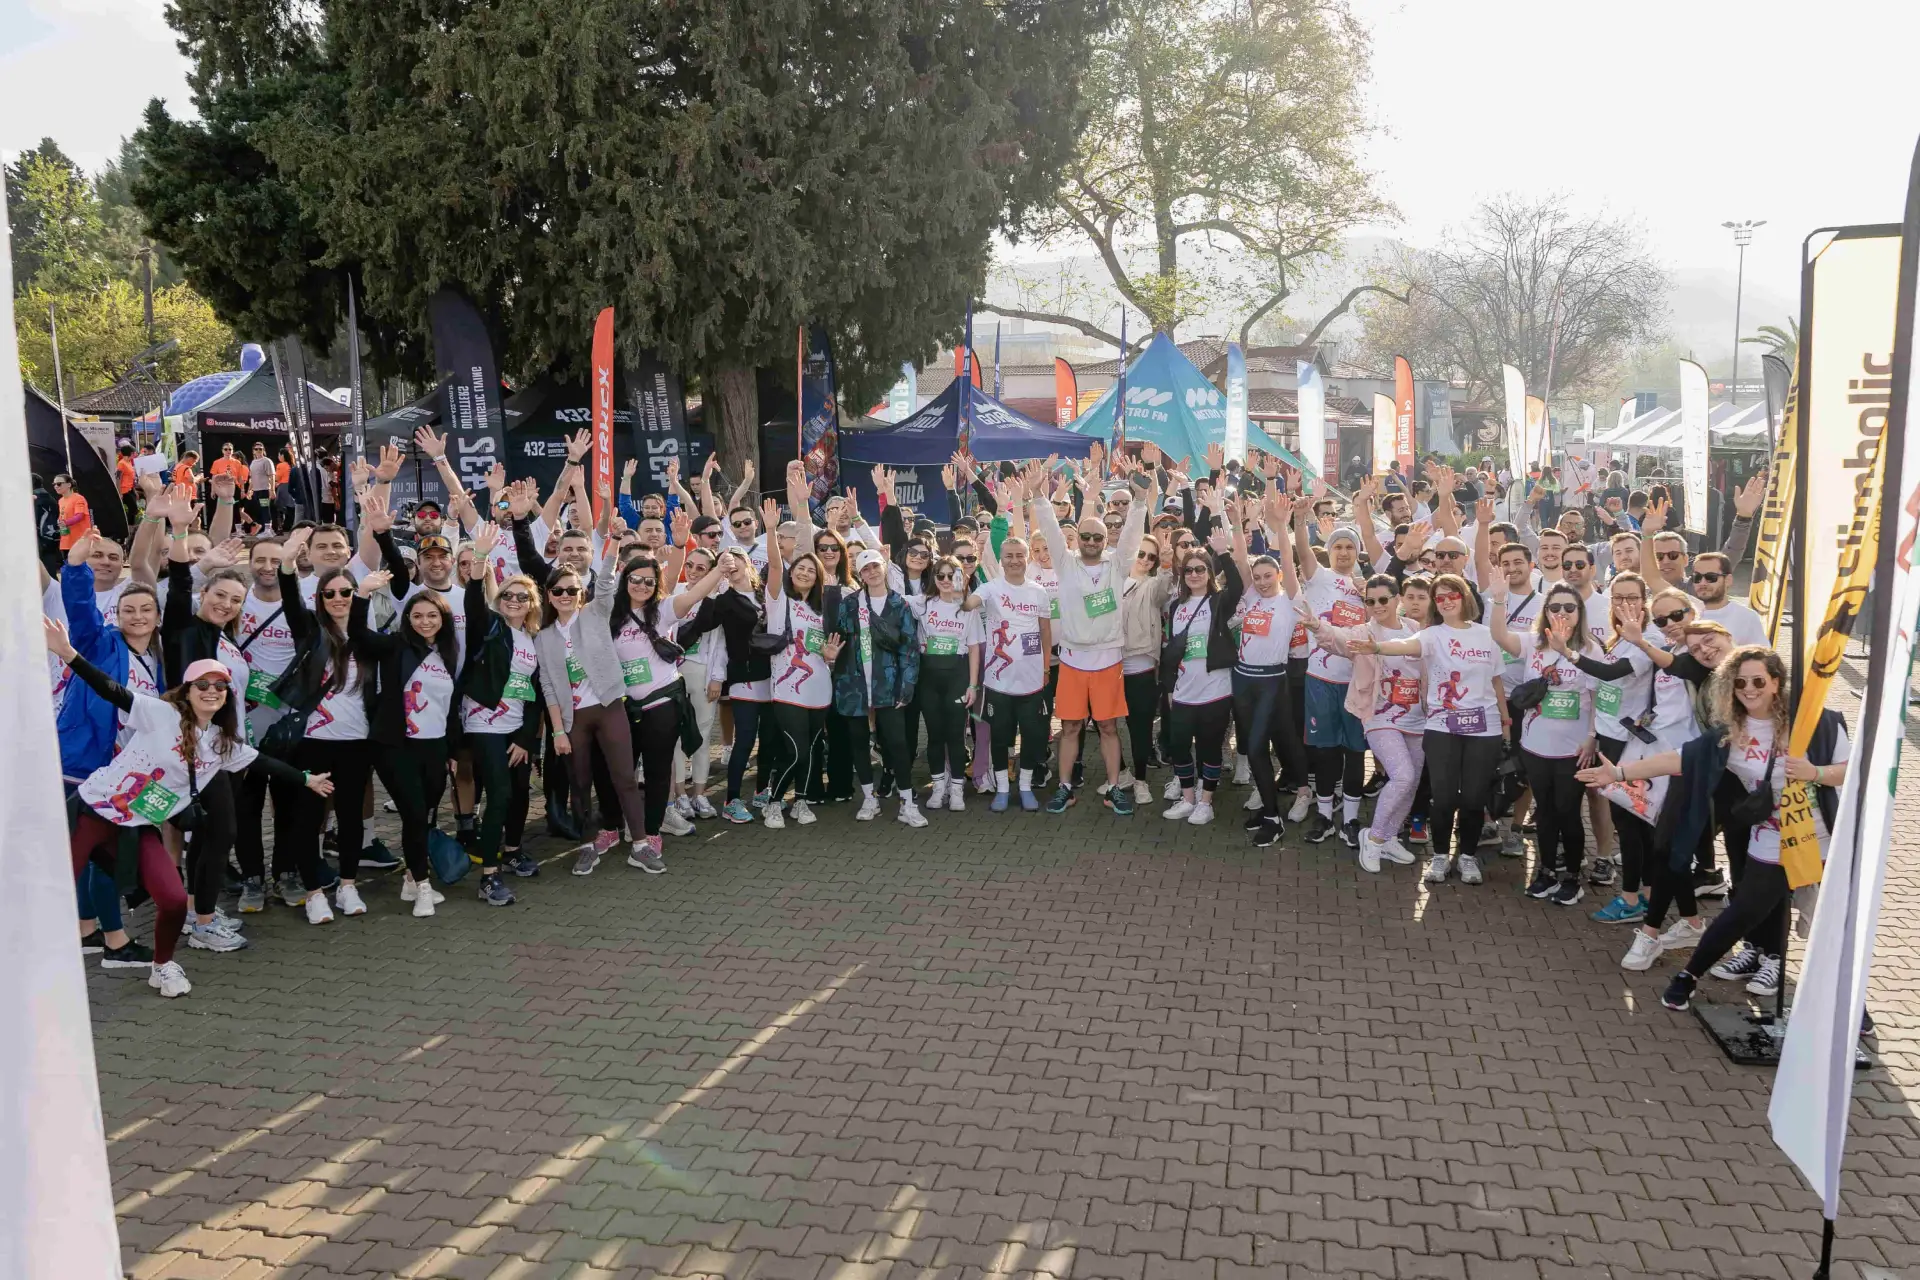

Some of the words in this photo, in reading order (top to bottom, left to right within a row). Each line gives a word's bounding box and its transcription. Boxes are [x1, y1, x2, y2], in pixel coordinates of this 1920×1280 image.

[1112, 406, 1149, 419] ETRO
[523, 440, 546, 457] 432
[1002, 599, 1038, 612] Aydem
[1340, 609, 1361, 620] 3066
[927, 617, 965, 630] Aydem
[810, 634, 824, 645] 263
[1450, 647, 1492, 660] Aydem
[1547, 697, 1575, 708] 2637
[1456, 715, 1479, 725] 1616
[143, 790, 169, 811] 2602
